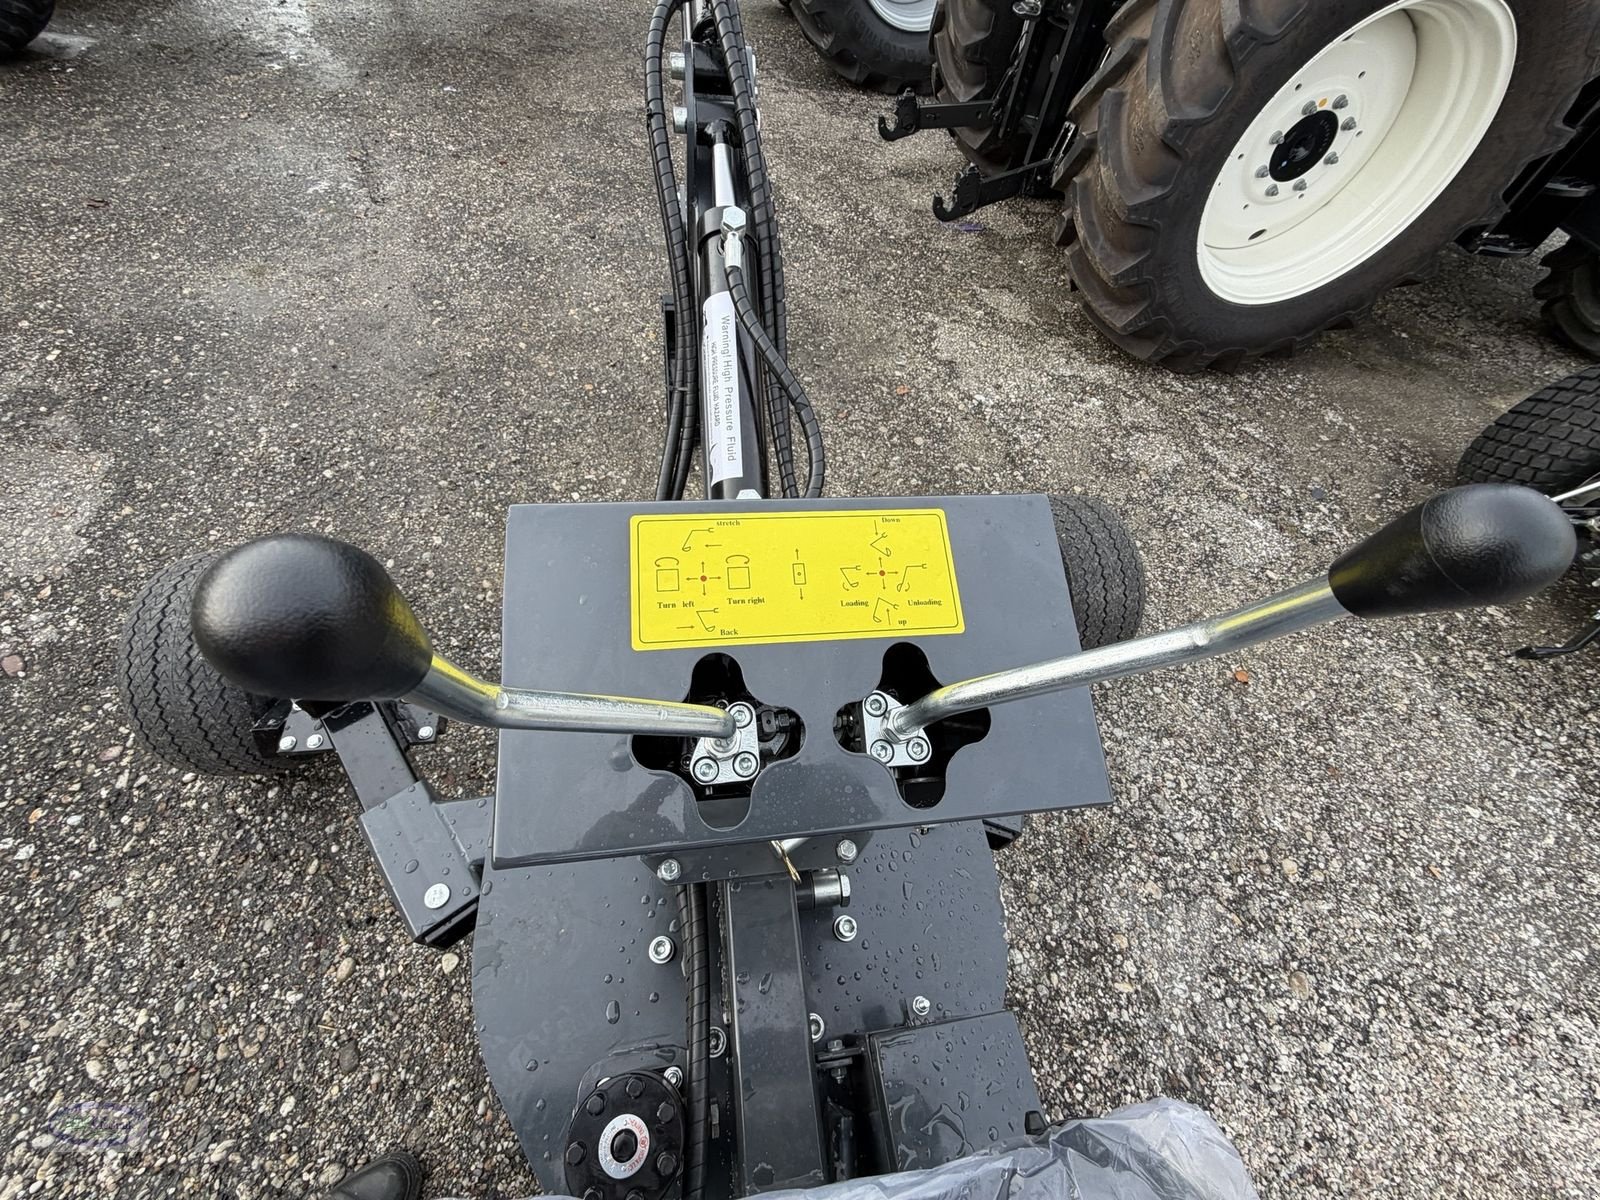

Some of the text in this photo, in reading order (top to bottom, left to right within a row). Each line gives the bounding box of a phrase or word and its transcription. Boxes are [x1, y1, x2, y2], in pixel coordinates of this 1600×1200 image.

[721, 315, 737, 461] Warning! High Pressure Fluid
[657, 600, 695, 609] Turn left
[727, 596, 765, 605] Turn right
[840, 599, 869, 607] Loading
[907, 598, 943, 606] Unloading
